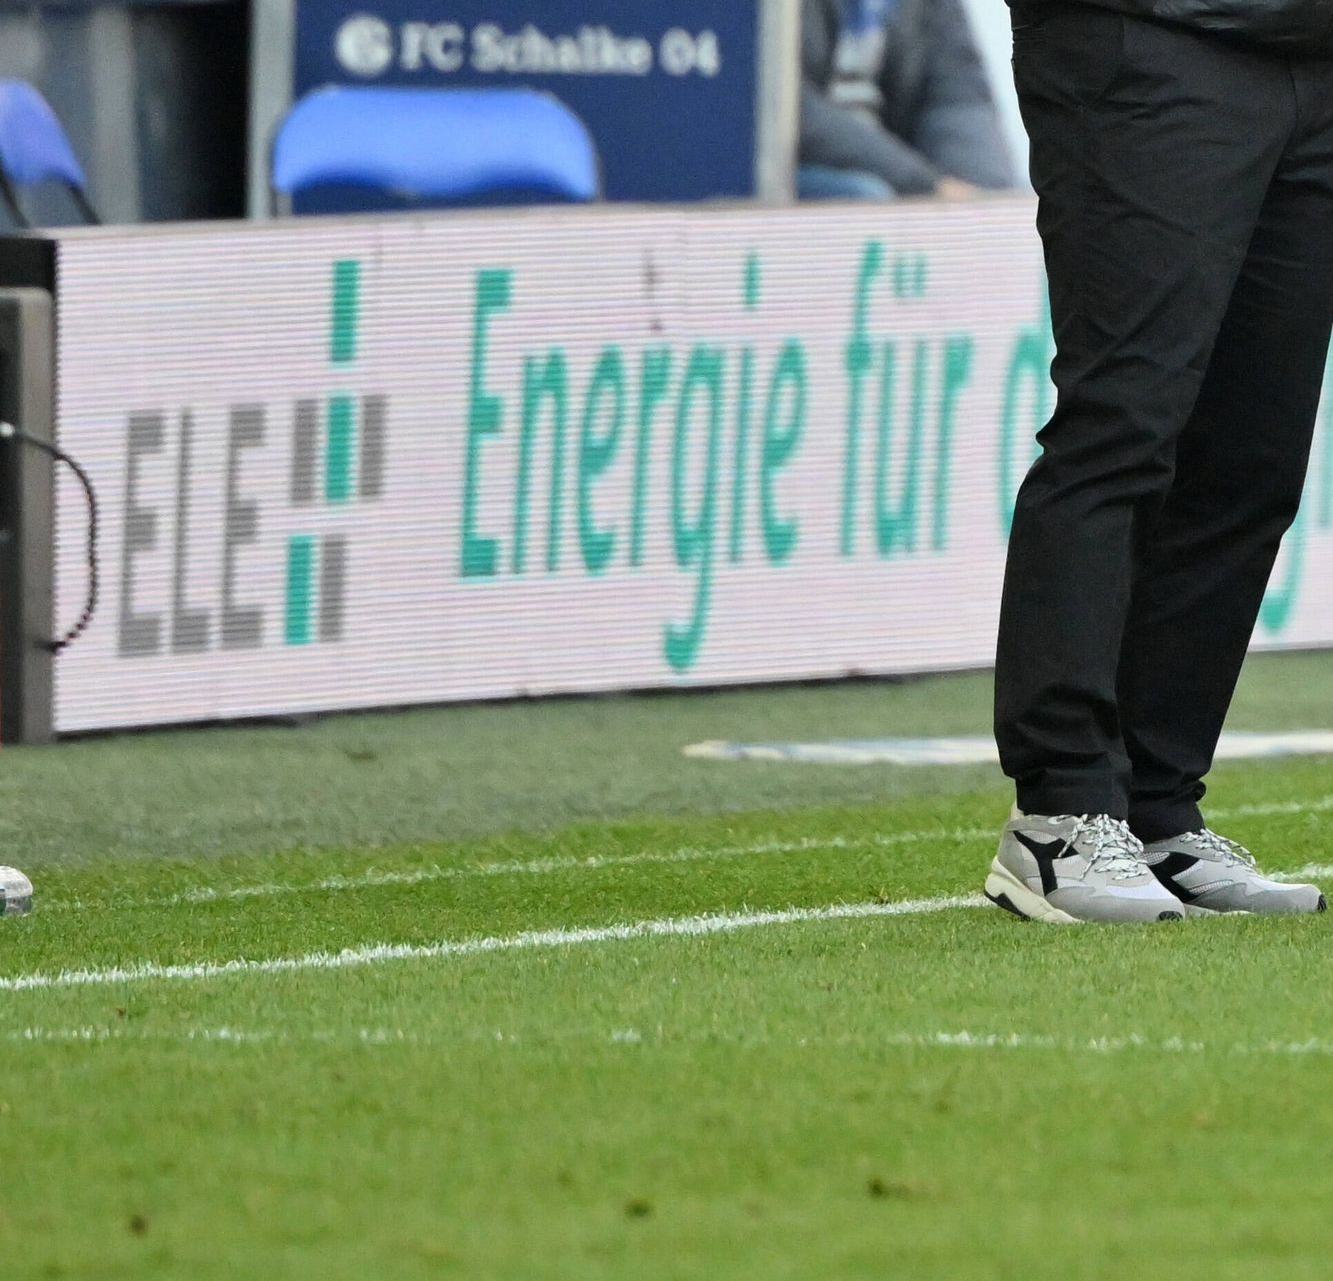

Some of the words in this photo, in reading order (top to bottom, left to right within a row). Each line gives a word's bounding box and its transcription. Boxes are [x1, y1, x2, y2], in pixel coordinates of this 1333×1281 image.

[402, 22, 465, 72] FC
[472, 24, 654, 75] Schalke
[659, 27, 721, 77] 04
[118, 406, 267, 657] ELE
[459, 253, 811, 674] Energie
[840, 238, 977, 560] für
